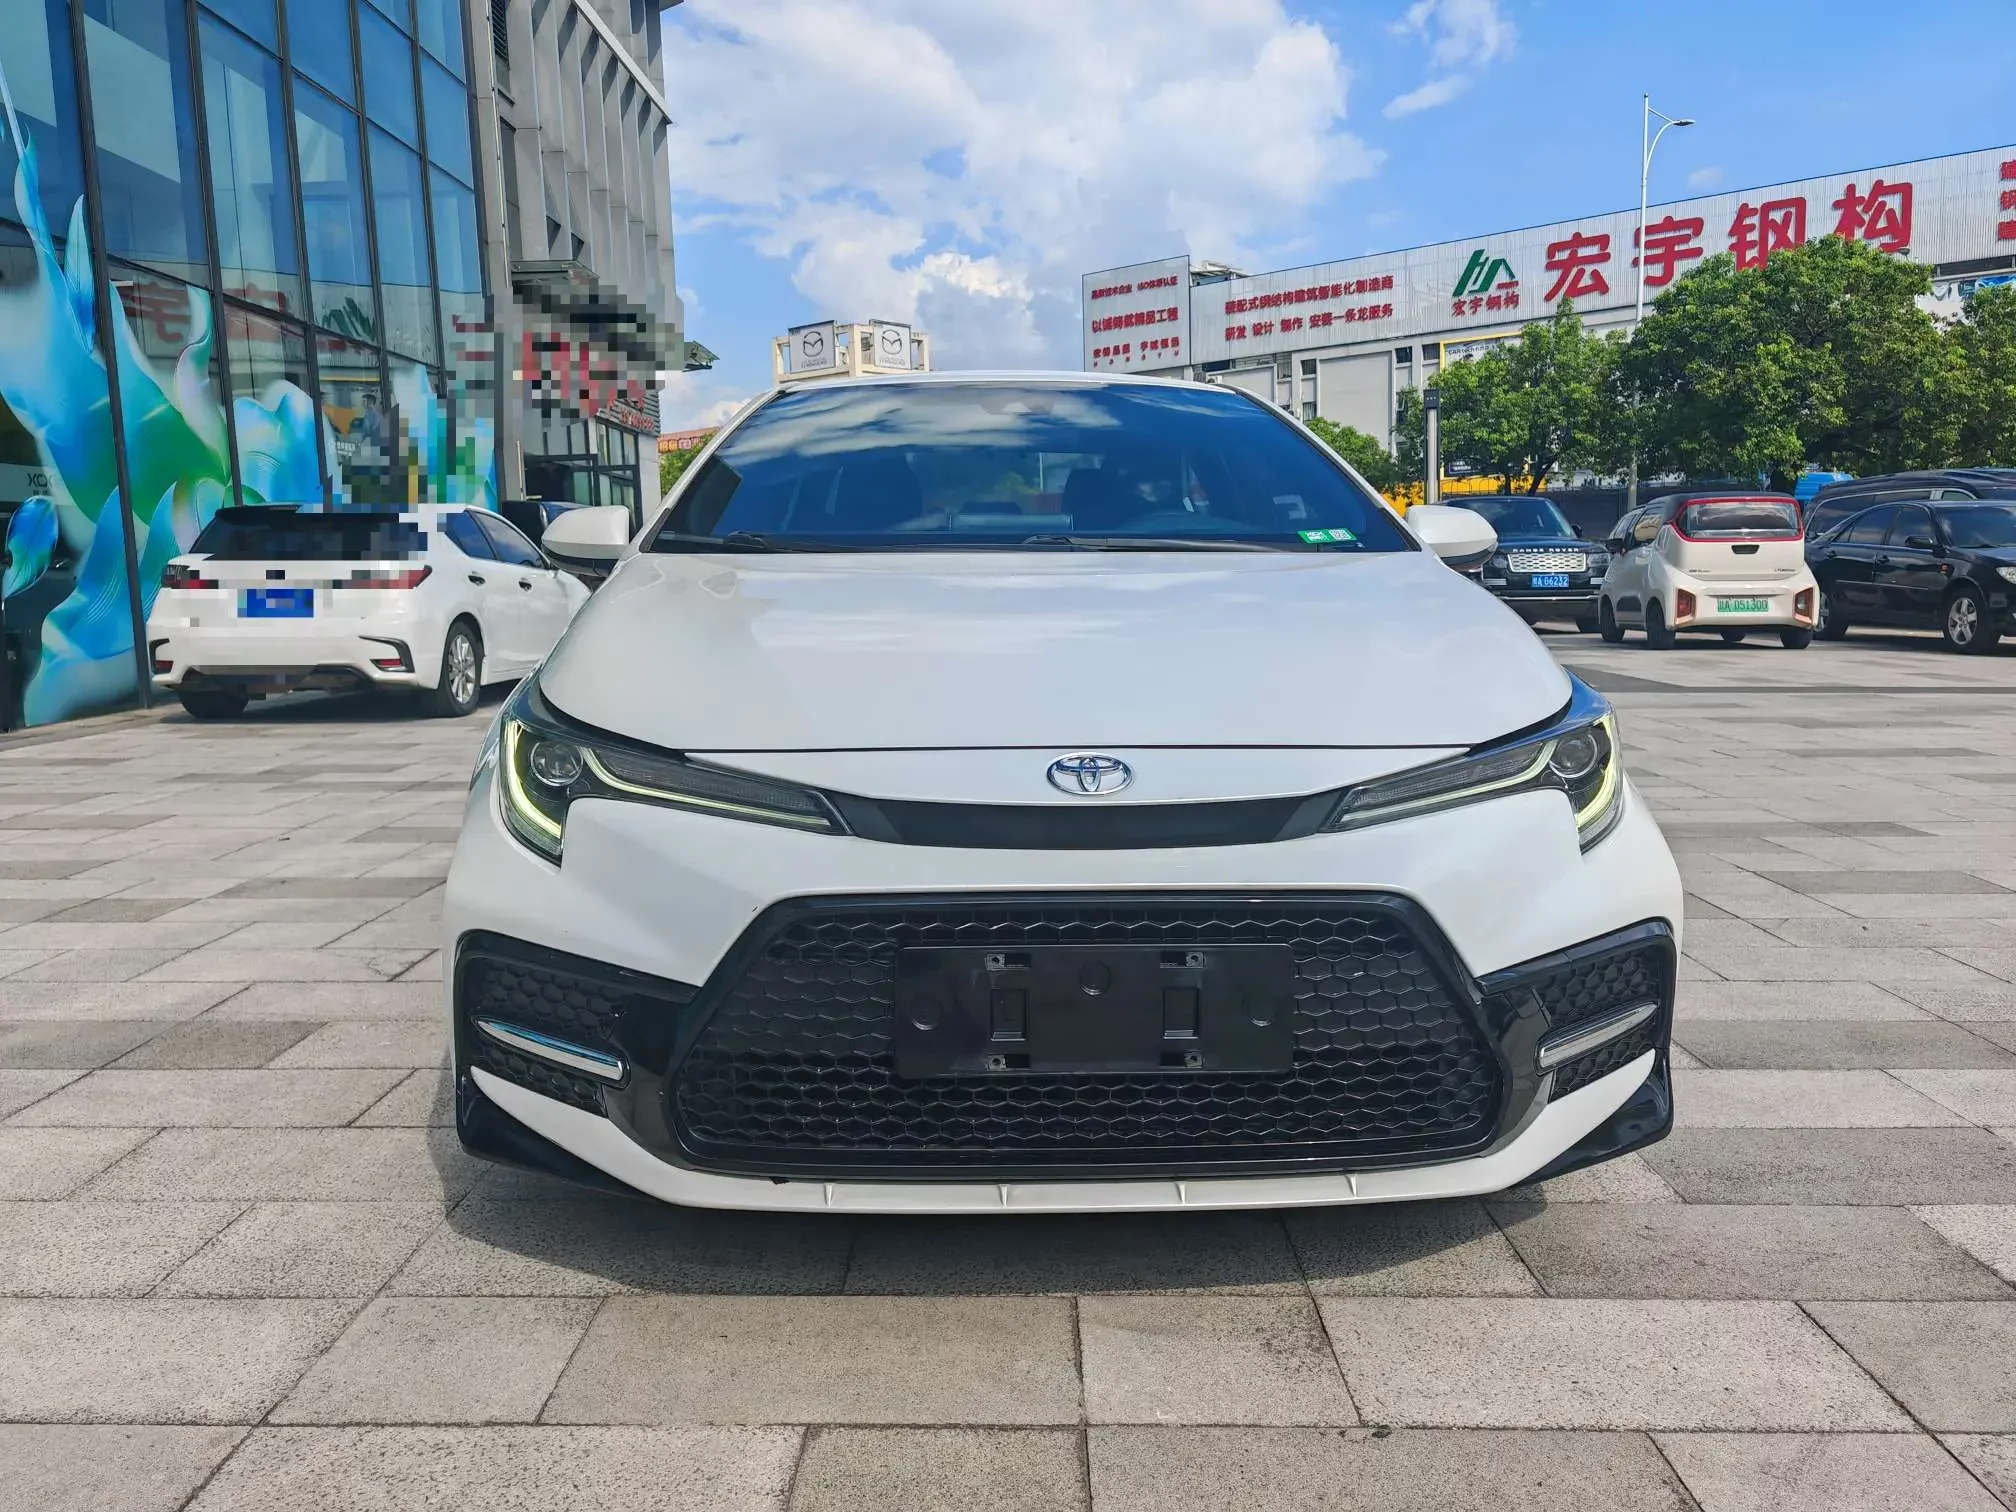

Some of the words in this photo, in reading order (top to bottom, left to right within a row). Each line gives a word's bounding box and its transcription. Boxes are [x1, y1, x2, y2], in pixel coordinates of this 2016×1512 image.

[1544, 180, 1912, 302] 宏宇钢构
[1224, 275, 1394, 315] 装配式钢结构建筑智能化制造商
[1225, 325, 1247, 341] 研发
[1252, 321, 1275, 337] 设计
[1280, 317, 1303, 333] 制作
[1309, 303, 1393, 329] 安装一条龙服务
